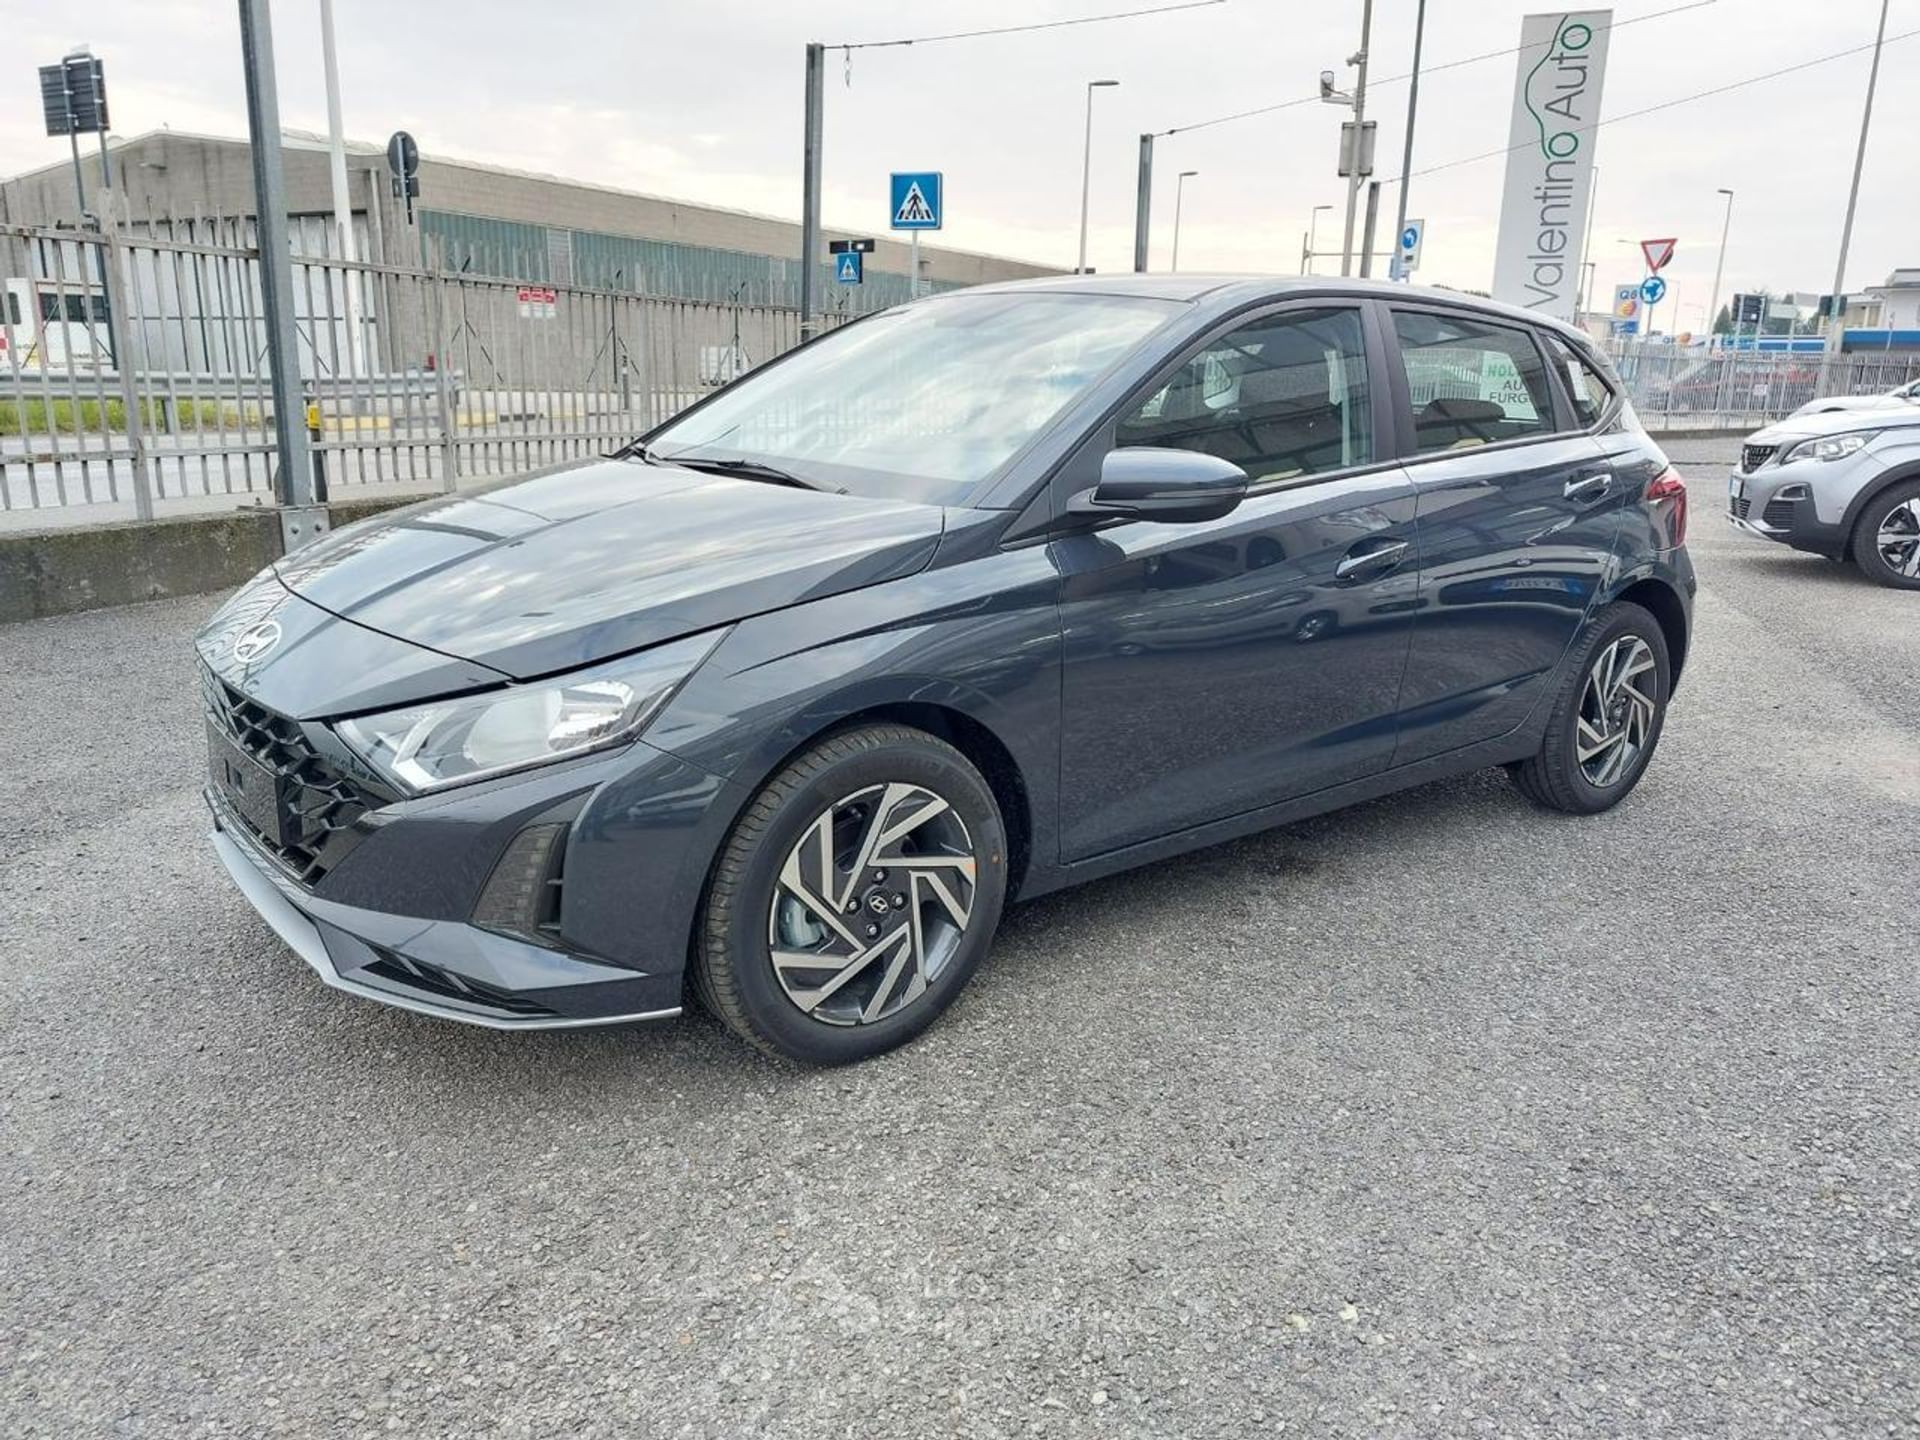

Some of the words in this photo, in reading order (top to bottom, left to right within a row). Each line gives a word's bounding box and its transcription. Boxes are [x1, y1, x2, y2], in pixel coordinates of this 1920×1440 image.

[1544, 24, 1592, 121] Auto
[1522, 131, 1578, 308] Valentino
[1489, 392, 1529, 403] FURG
